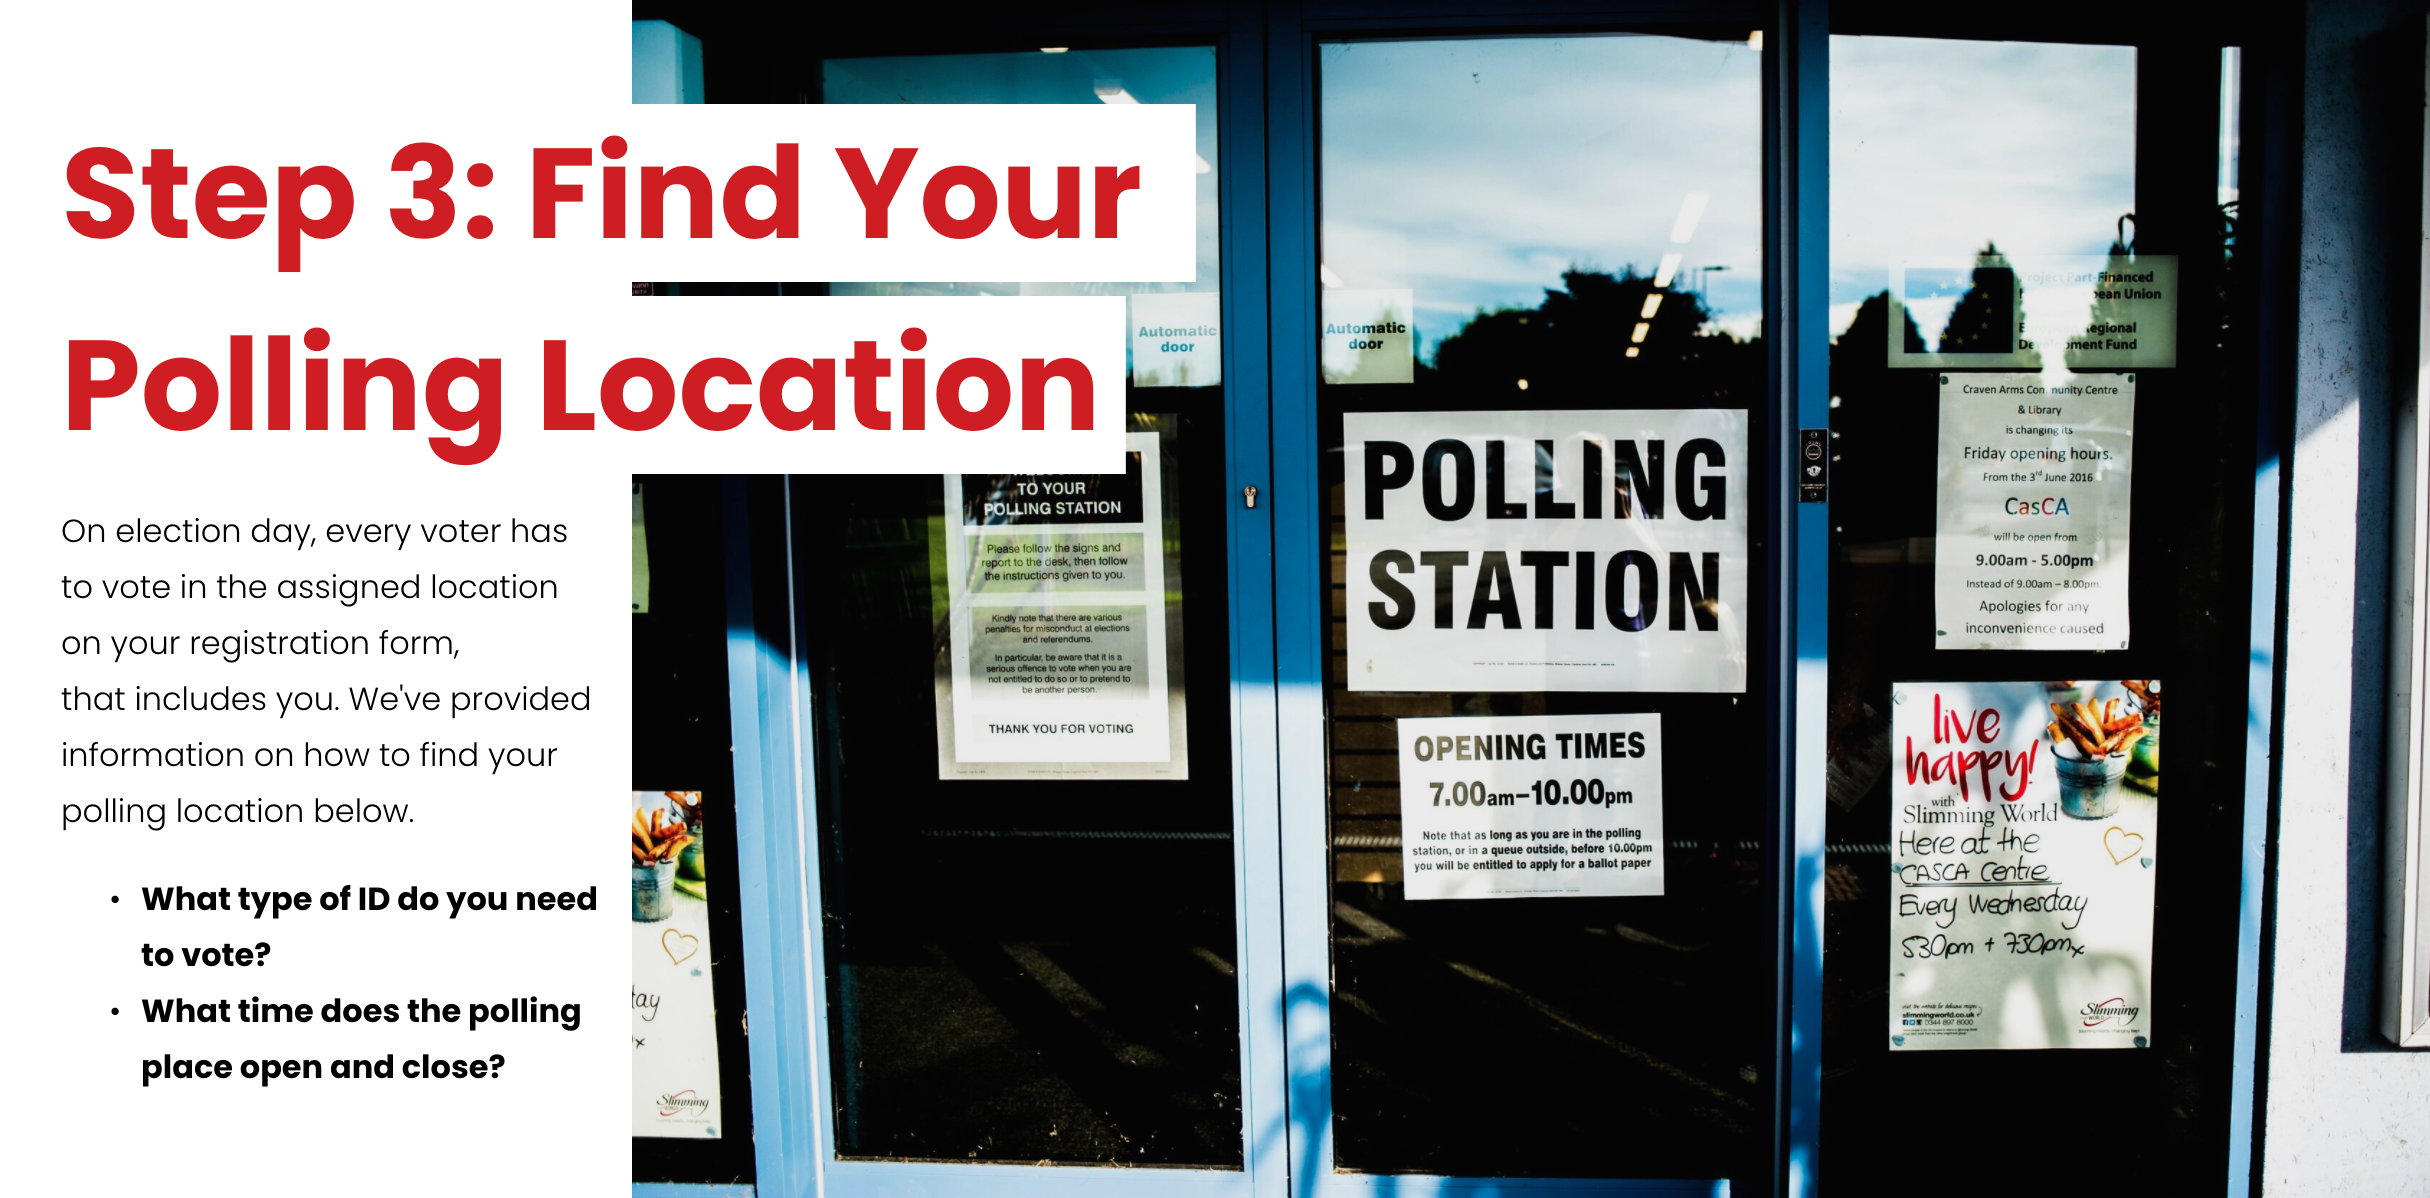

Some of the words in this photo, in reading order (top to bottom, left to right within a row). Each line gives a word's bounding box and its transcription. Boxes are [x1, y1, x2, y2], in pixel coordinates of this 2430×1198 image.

[2067, 271, 2154, 283] Part-Financed
[2124, 288, 2161, 299] Union
[1138, 325, 1216, 337] Automatic
[1326, 321, 1406, 334] Automatic
[1161, 341, 1195, 353] door
[1349, 338, 1384, 350] door
[2106, 338, 2137, 350] Fund
[1963, 384, 1997, 394] Craven
[1999, 384, 2024, 394] Arms
[2085, 386, 2119, 394] Centre
[2018, 405, 2025, 414] &
[2028, 405, 2062, 416] Library
[2006, 425, 2014, 434] is
[2015, 425, 2059, 437] changing
[2061, 425, 2073, 435] its
[1964, 446, 2006, 461] Friday
[2010, 447, 2066, 463] opening
[2070, 447, 2113, 460] hours.
[1364, 438, 1726, 521] POLLING
[1983, 472, 2008, 482] From
[2011, 473, 2027, 482] the
[2044, 473, 2067, 482] June
[2069, 473, 2093, 482] 2016
[1017, 482, 1039, 496] TO
[1042, 482, 1086, 495] YOUR
[984, 502, 1051, 515] POLLING
[1056, 501, 1121, 515] STATION
[2005, 497, 2069, 515] CasCA
[987, 544, 1020, 554] Please
[1022, 544, 1051, 554] follow
[1054, 543, 1070, 553] the
[1072, 543, 1099, 555] signs
[1102, 542, 1121, 552] and
[981, 558, 1011, 570] report
[1013, 558, 1024, 567] to
[1026, 557, 1042, 567] the
[1045, 556, 1071, 567] desk,
[1073, 557, 1096, 566] then
[1098, 556, 1128, 566] follow
[1976, 554, 2028, 566] 9.00am
[2041, 554, 2094, 569] 5.00pm
[984, 571, 1000, 581] the
[1003, 571, 1060, 581] instructions
[1062, 570, 1089, 582] given
[1091, 571, 1102, 580] to
[1104, 571, 1125, 581] you.
[1368, 549, 1719, 632] STATION
[1966, 579, 2002, 589] Instead
[2003, 578, 2015, 589] of
[2016, 579, 2053, 589] 9.00am
[992, 614, 1017, 624] Kindly
[1038, 614, 1054, 622] that
[1055, 614, 1077, 622] there
[1093, 614, 1123, 622] various
[1966, 622, 2057, 634] inconvenience
[2060, 622, 2104, 634] caused
[1934, 693, 2000, 744] live
[989, 724, 1029, 734] THANK
[1032, 724, 1057, 734] YOU
[1061, 724, 1085, 734] FOR
[1088, 724, 1134, 734] VOTING
[1414, 733, 1546, 762] OPENING
[1555, 731, 1645, 759] TIMES
[1906, 735, 2039, 802] happy!
[1931, 795, 1955, 807] with
[1903, 804, 1995, 828] Slimming
[2000, 803, 2058, 822] World
[1423, 831, 1447, 840] Note
[1450, 831, 1471, 840] that
[1474, 832, 1487, 840] as
[1490, 830, 1512, 842] long
[1515, 831, 1528, 840] as
[1530, 831, 1549, 841] you
[1552, 831, 1570, 839] are
[1573, 828, 1583, 838] in
[1585, 828, 1603, 838] the
[1605, 827, 1641, 841] polling
[1899, 830, 1955, 856] Here
[1961, 826, 1991, 854] at
[1997, 827, 2040, 853] the
[1412, 846, 1452, 856] station,
[1455, 847, 1465, 855] or
[1469, 845, 1478, 855] in
[1481, 847, 1488, 855] a
[1491, 846, 1523, 857] queue
[1526, 844, 1568, 855] outside,
[1571, 843, 1605, 854] before
[1608, 843, 1652, 855] 10.00pm
[1414, 863, 1432, 873] you
[1435, 860, 1454, 870] will
[1457, 861, 1470, 870] be
[1473, 859, 1513, 870] entitled
[1516, 860, 1527, 869] to
[1530, 859, 1558, 872] apply
[1560, 858, 1575, 869] for
[1578, 860, 1585, 869] a
[1588, 858, 1618, 869] ballot
[1621, 859, 1652, 870] paper
[1899, 863, 1970, 884] CASCA
[1981, 855, 2050, 882] Centre
[1899, 894, 1957, 929] Every
[1969, 887, 2088, 930] Wednesday
[1902, 1011, 1975, 1020] slimmingworld.co.uk
[2080, 1002, 2139, 1024] Slimming
[656, 1094, 709, 1114] Slimming
